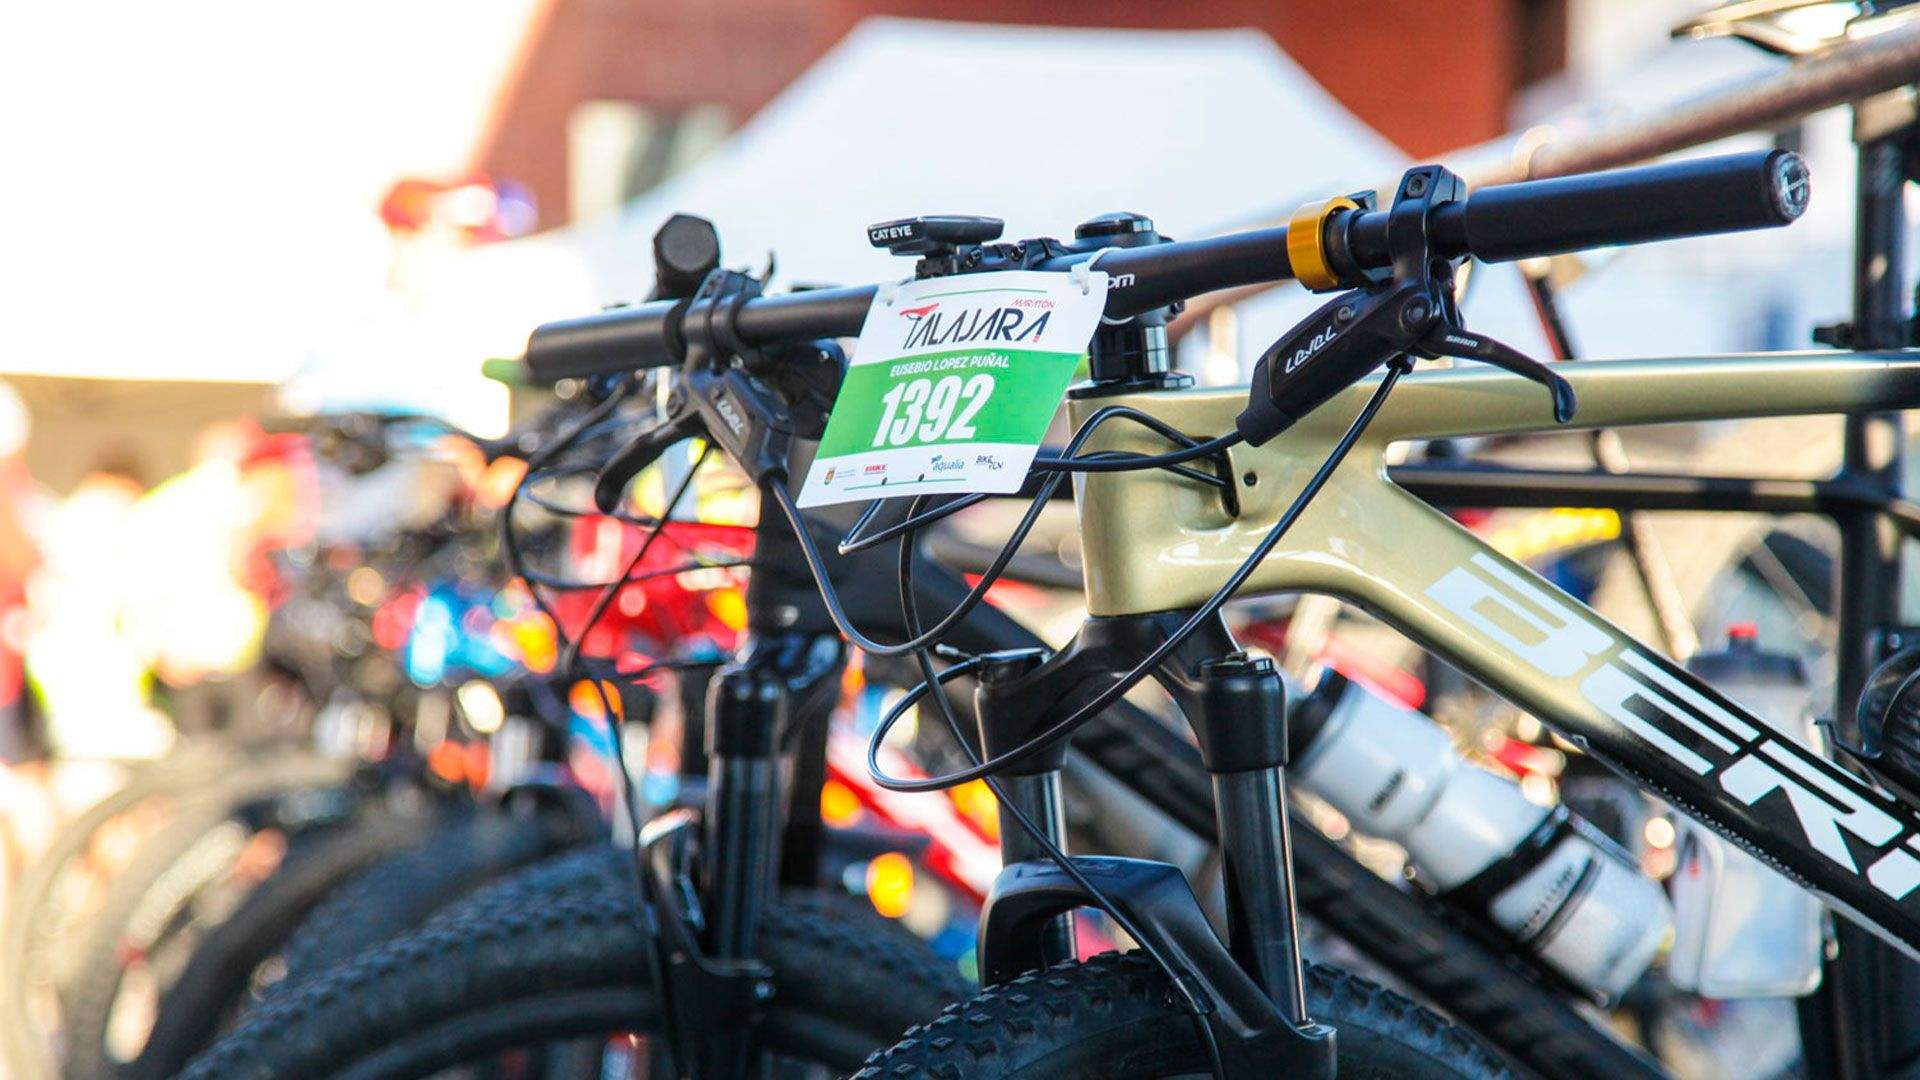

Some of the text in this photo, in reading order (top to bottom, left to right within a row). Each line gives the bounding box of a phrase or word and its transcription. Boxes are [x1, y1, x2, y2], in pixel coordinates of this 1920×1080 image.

[871, 225, 912, 241] CATEYE
[889, 352, 1010, 378] EUSEBIO LOPEZ PUÑAL
[872, 373, 995, 448] 1392
